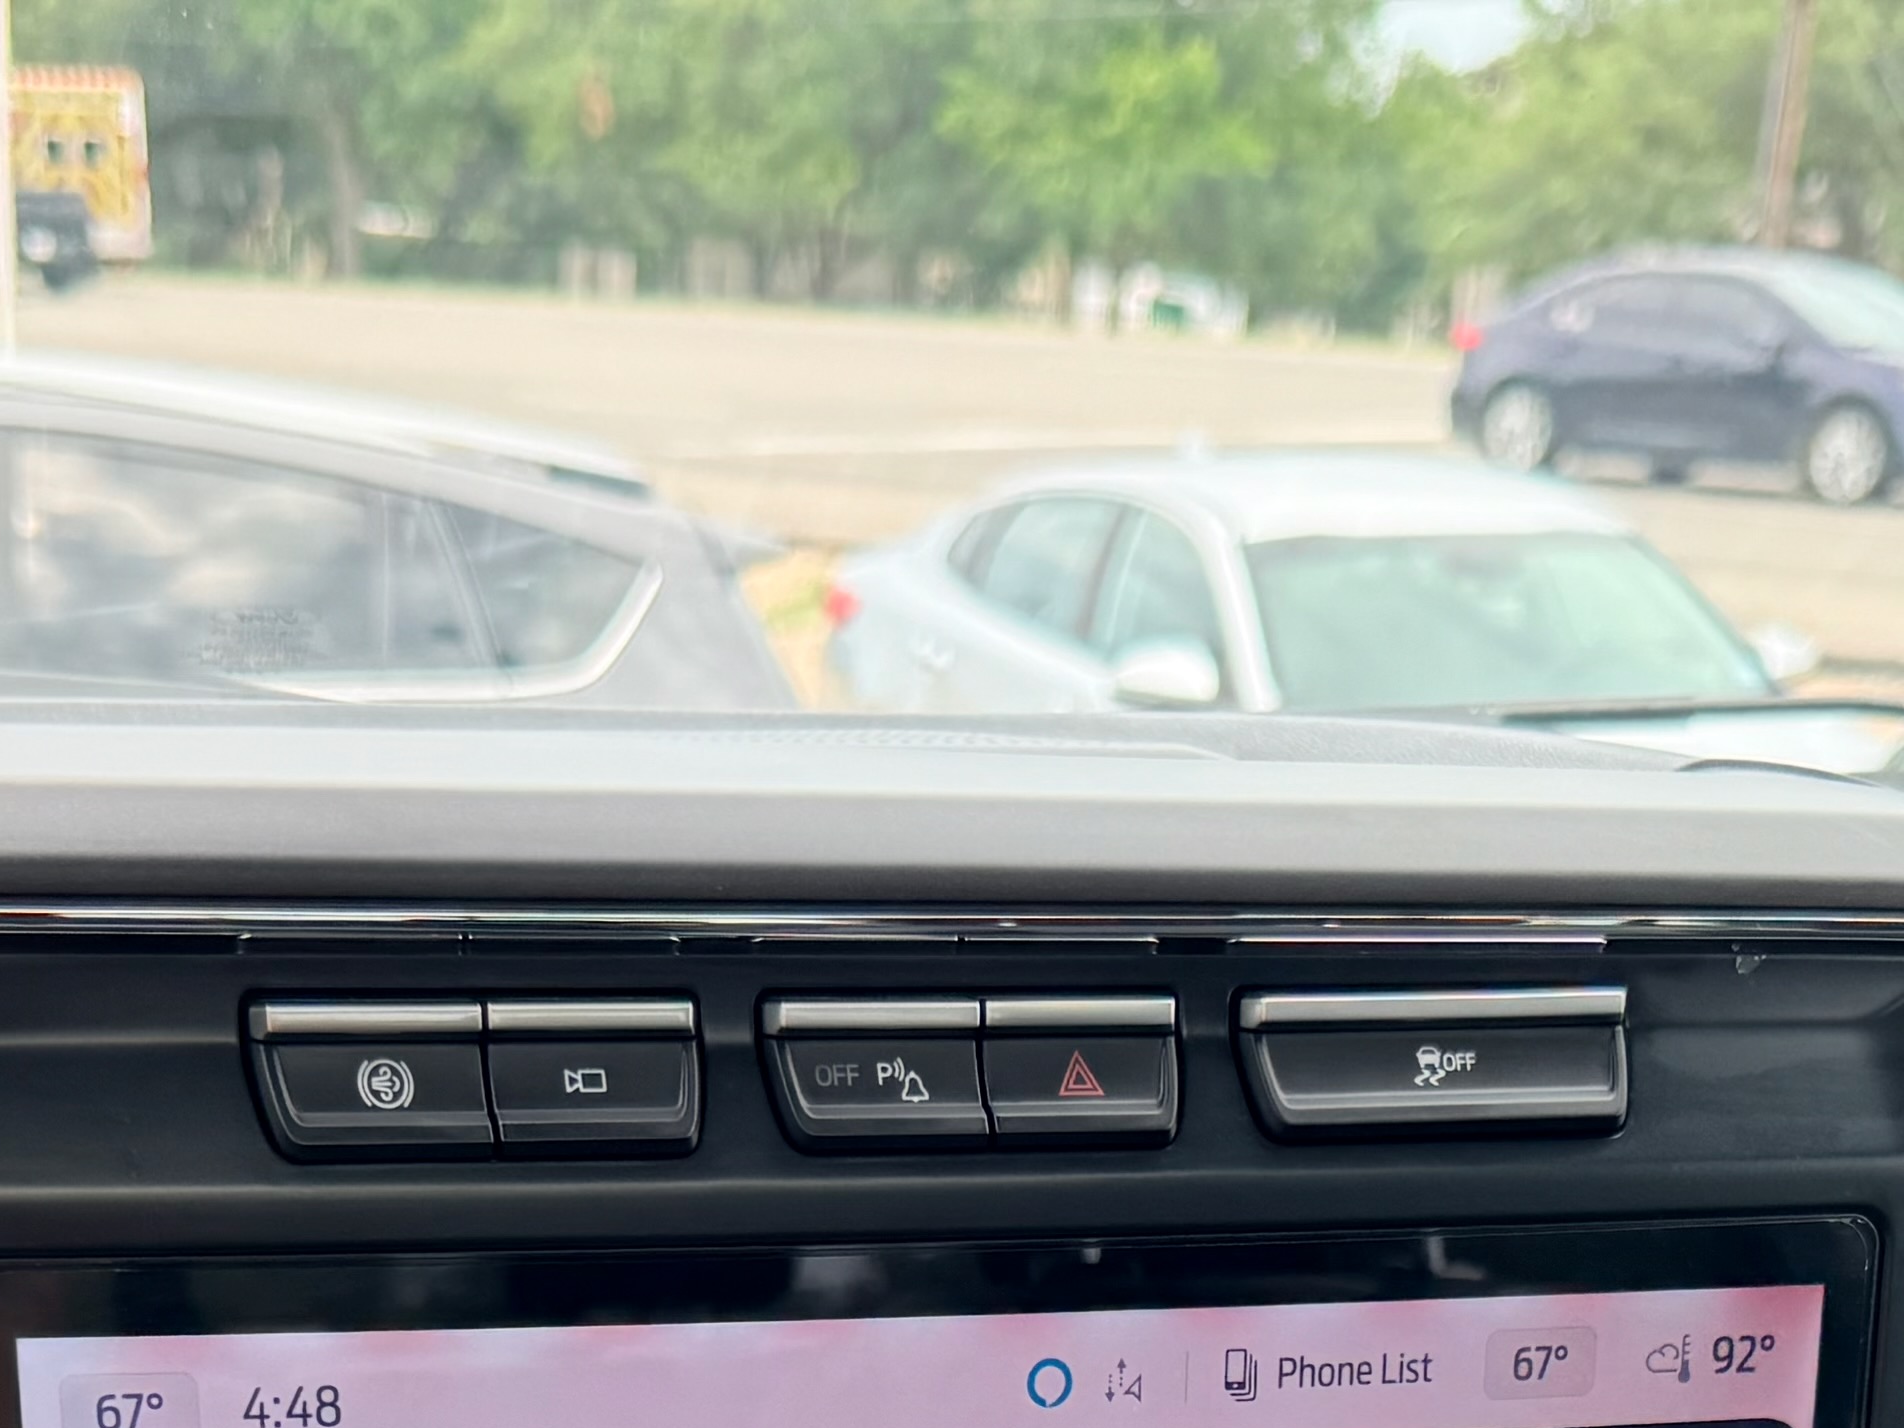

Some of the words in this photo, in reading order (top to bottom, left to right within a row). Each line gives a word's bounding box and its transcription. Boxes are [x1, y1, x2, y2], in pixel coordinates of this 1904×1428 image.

[814, 1063, 860, 1088] OFF
[1442, 1049, 1476, 1073] OFF
[1277, 1354, 1373, 1390] Phone
[1380, 1350, 1434, 1385] List
[1512, 1344, 1569, 1381] 67°
[1711, 1334, 1776, 1375] 92°
